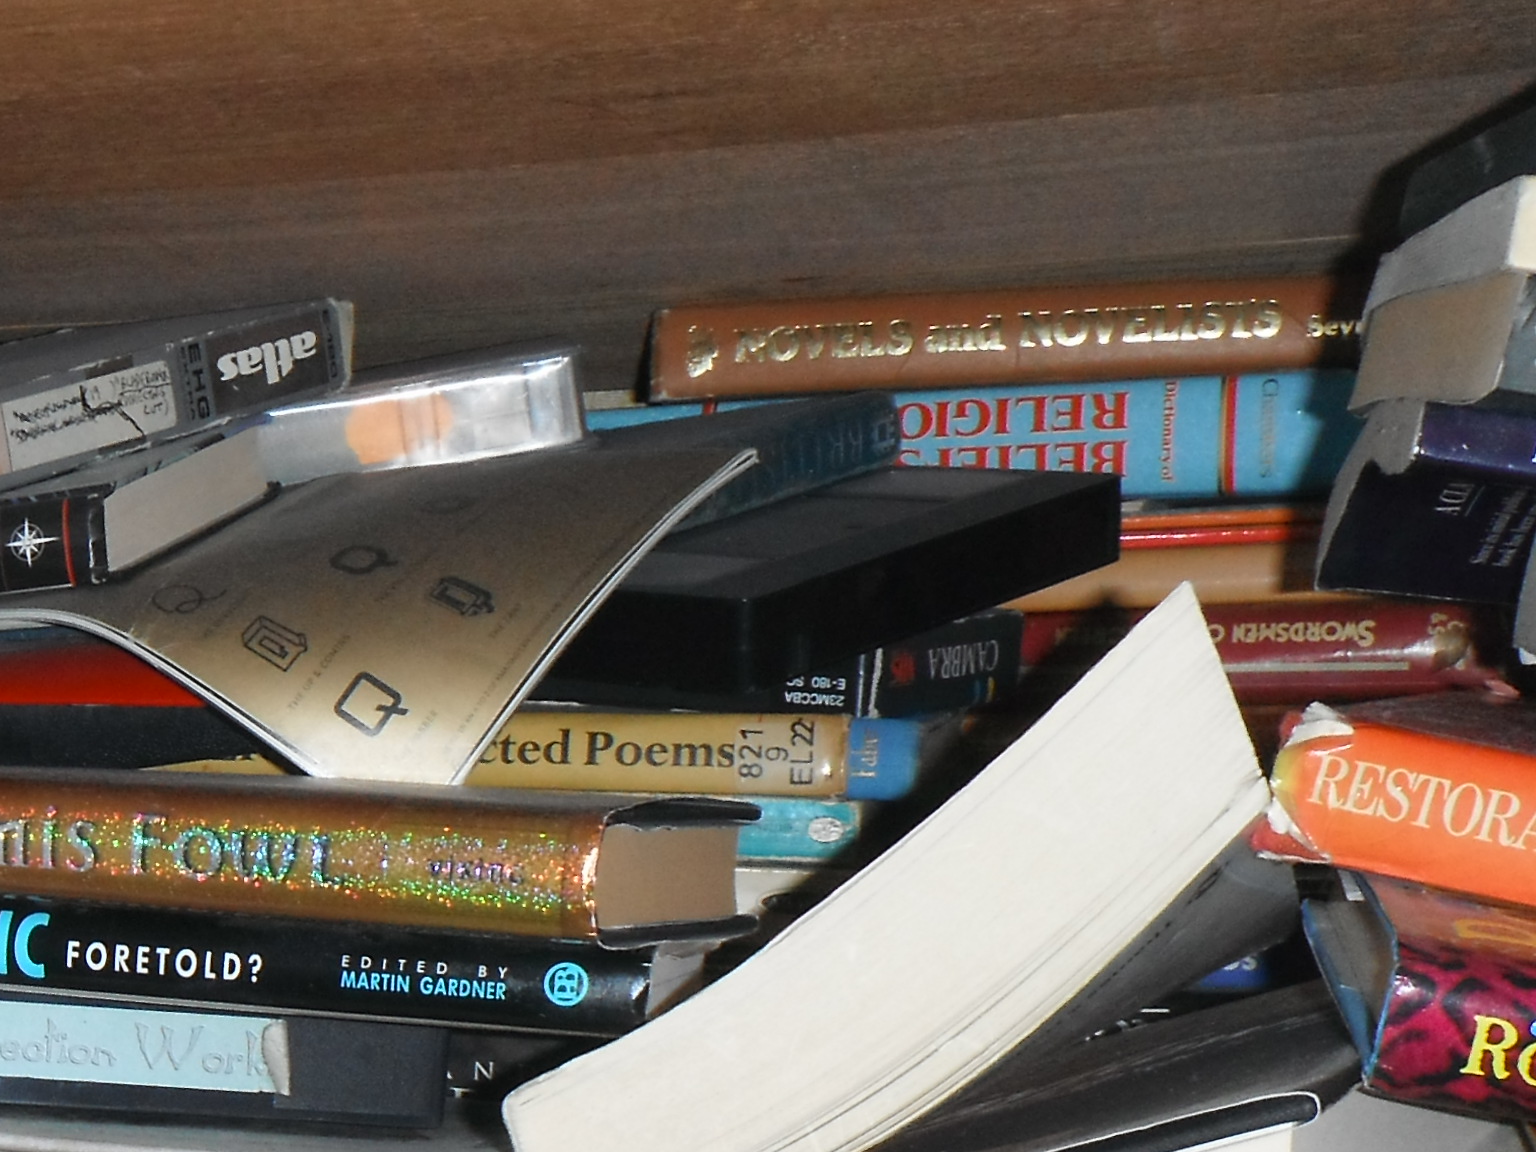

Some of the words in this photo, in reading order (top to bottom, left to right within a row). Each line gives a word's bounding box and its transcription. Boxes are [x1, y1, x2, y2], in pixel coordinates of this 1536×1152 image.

[732, 319, 913, 363] NOVELS
[925, 314, 1007, 354] and
[1018, 299, 1283, 348] NOVELISTS
[217, 331, 317, 384] atlas
[1159, 381, 1178, 466] Dictionary
[1232, 620, 1374, 648] SWORDSMEN
[928, 640, 999, 681] CAMBRA
[811, 676, 845, 690] E-180
[584, 730, 736, 769] Poems
[738, 726, 766, 779] 821
[130, 812, 344, 887] FOWL
[66, 939, 263, 983] FORETOLD?
[341, 954, 448, 975] EDITED
[478, 964, 509, 980] BY
[340, 970, 410, 995] MARTIN
[419, 975, 506, 1001] GARDNER
